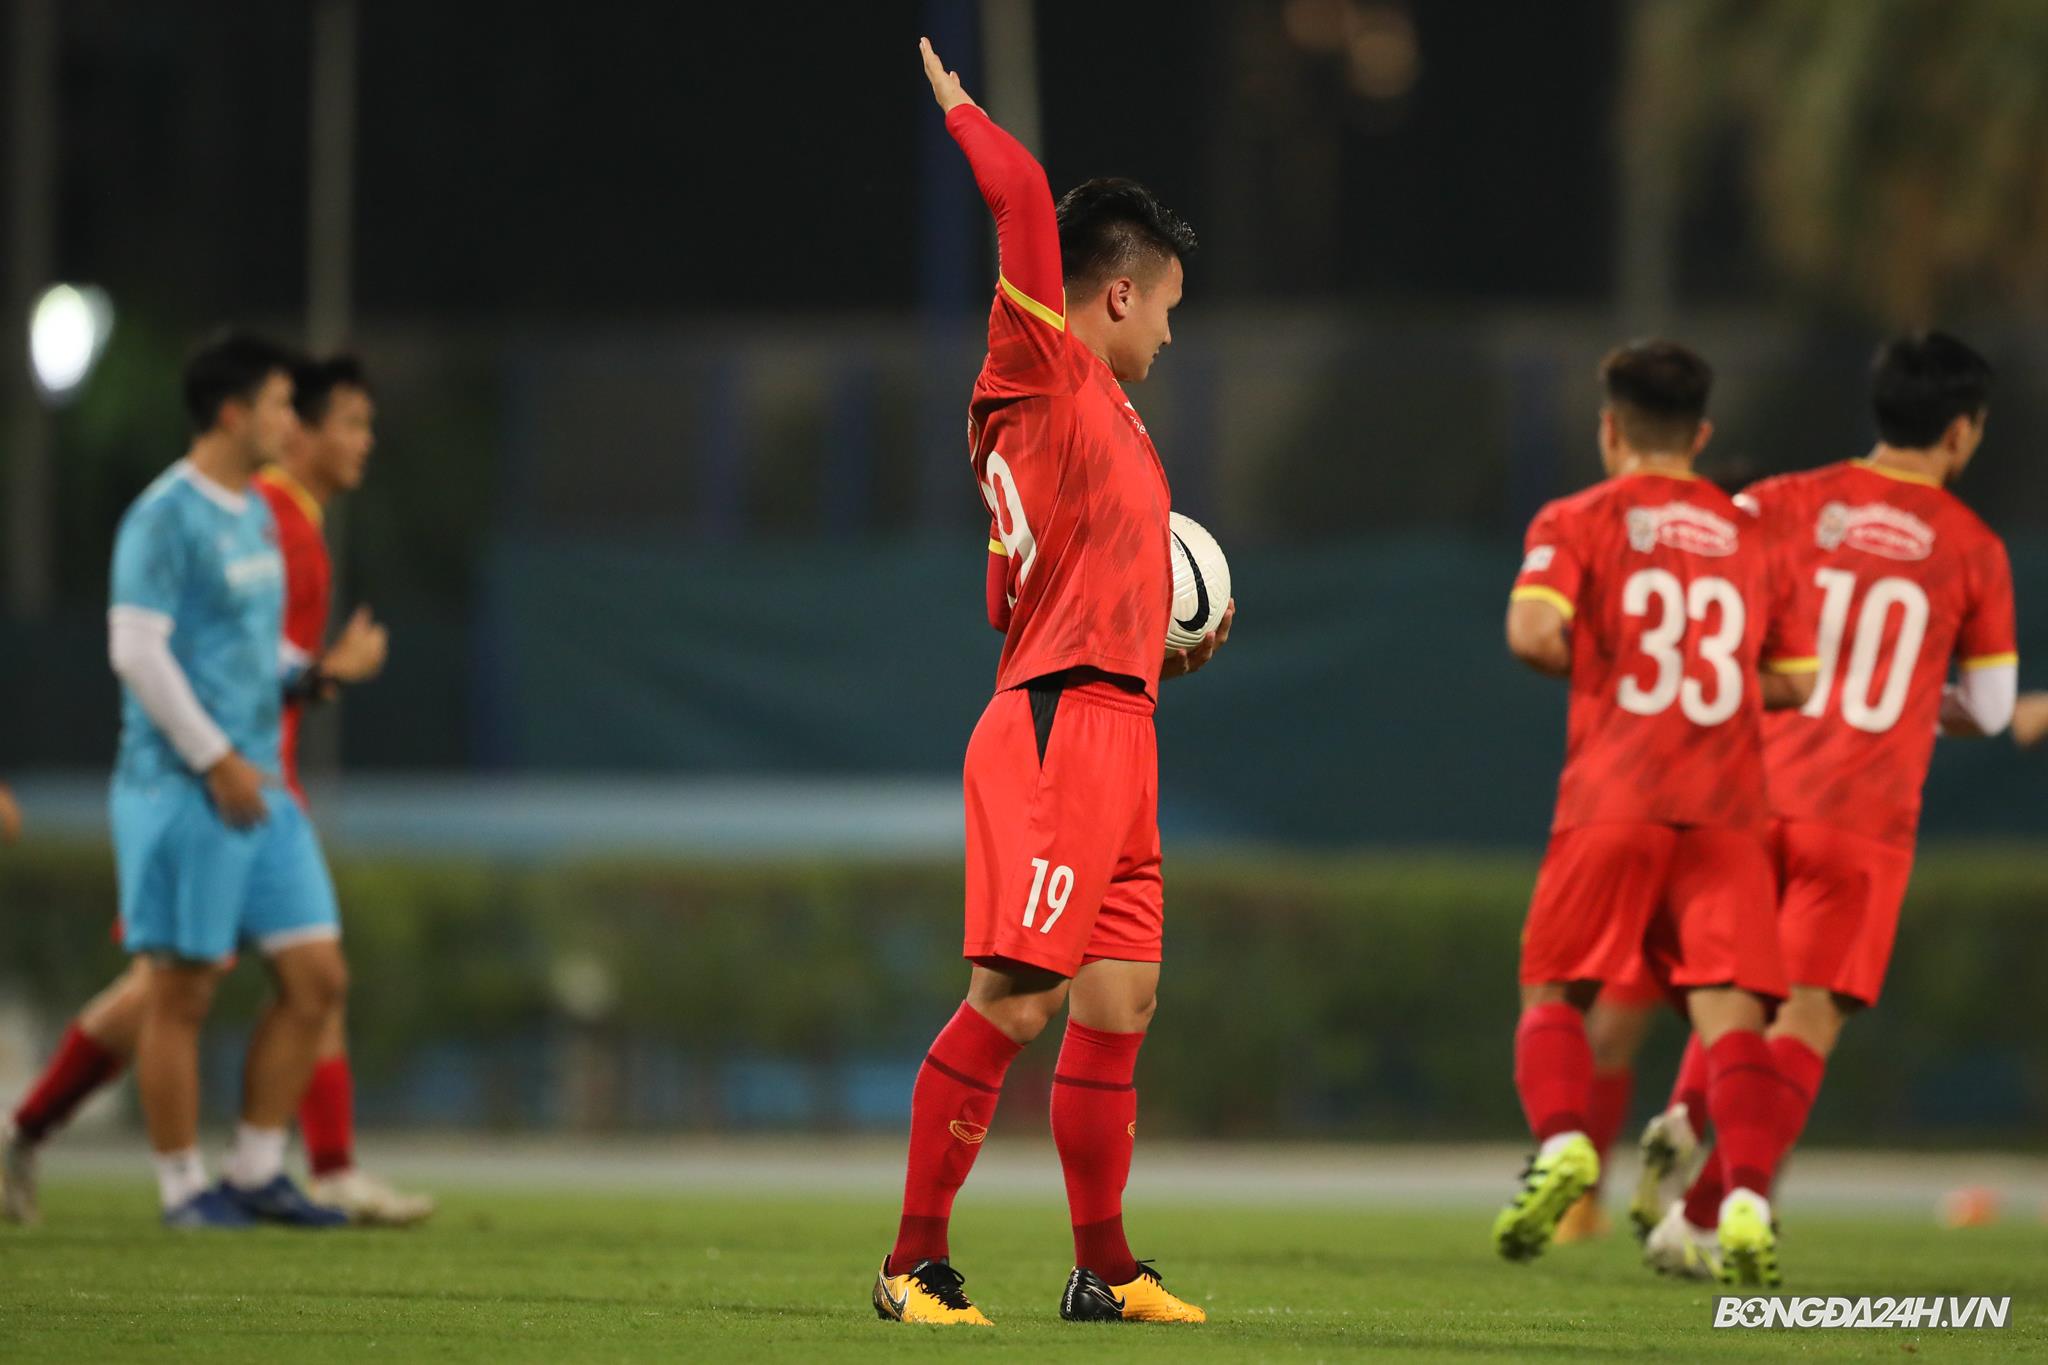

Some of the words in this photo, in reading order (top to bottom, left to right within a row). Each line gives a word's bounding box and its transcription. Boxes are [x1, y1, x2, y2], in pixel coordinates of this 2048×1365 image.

[1616, 567, 1746, 727] 33
[1800, 567, 1929, 734] 10
[1021, 857, 1075, 934] 19
